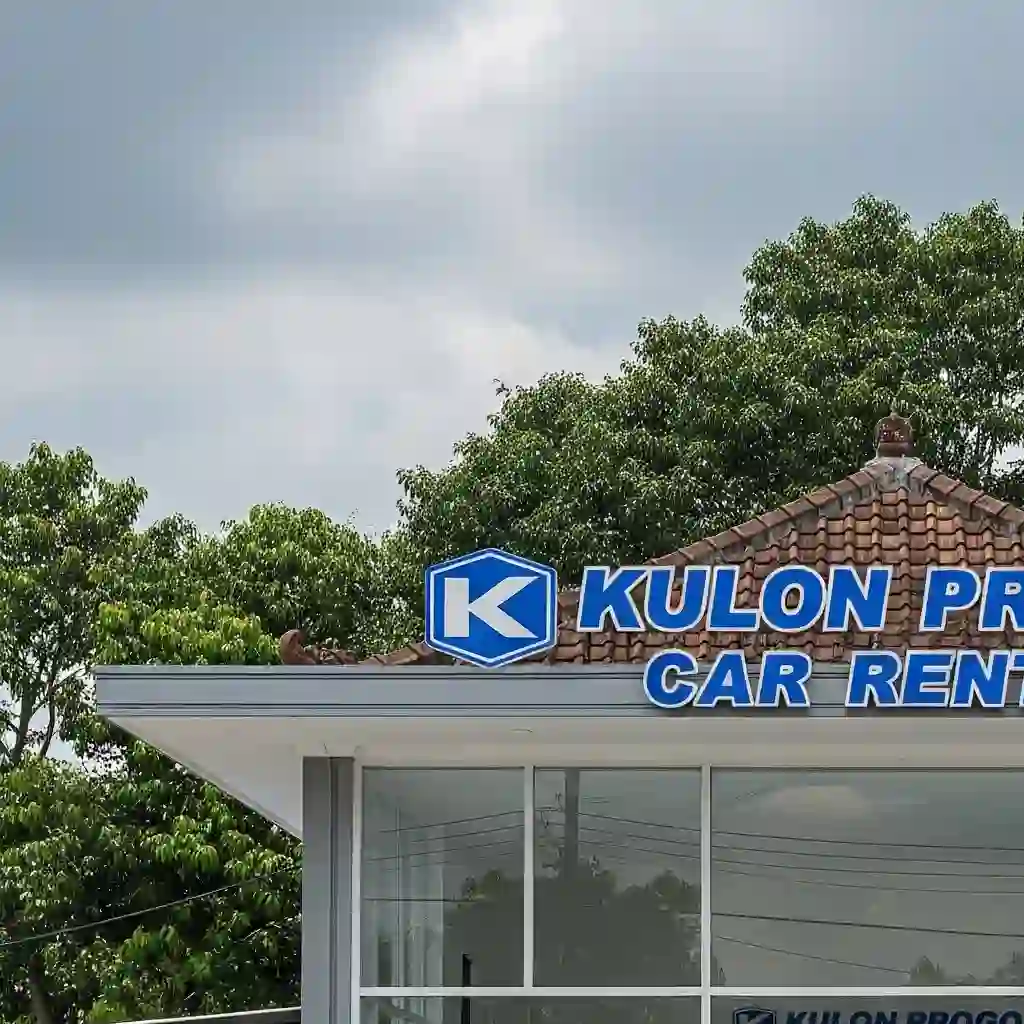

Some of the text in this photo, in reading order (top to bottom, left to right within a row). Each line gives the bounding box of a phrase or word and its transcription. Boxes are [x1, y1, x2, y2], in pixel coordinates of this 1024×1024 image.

[444, 576, 540, 639] K
[577, 564, 891, 633] KULON
[642, 648, 813, 709] CAR
